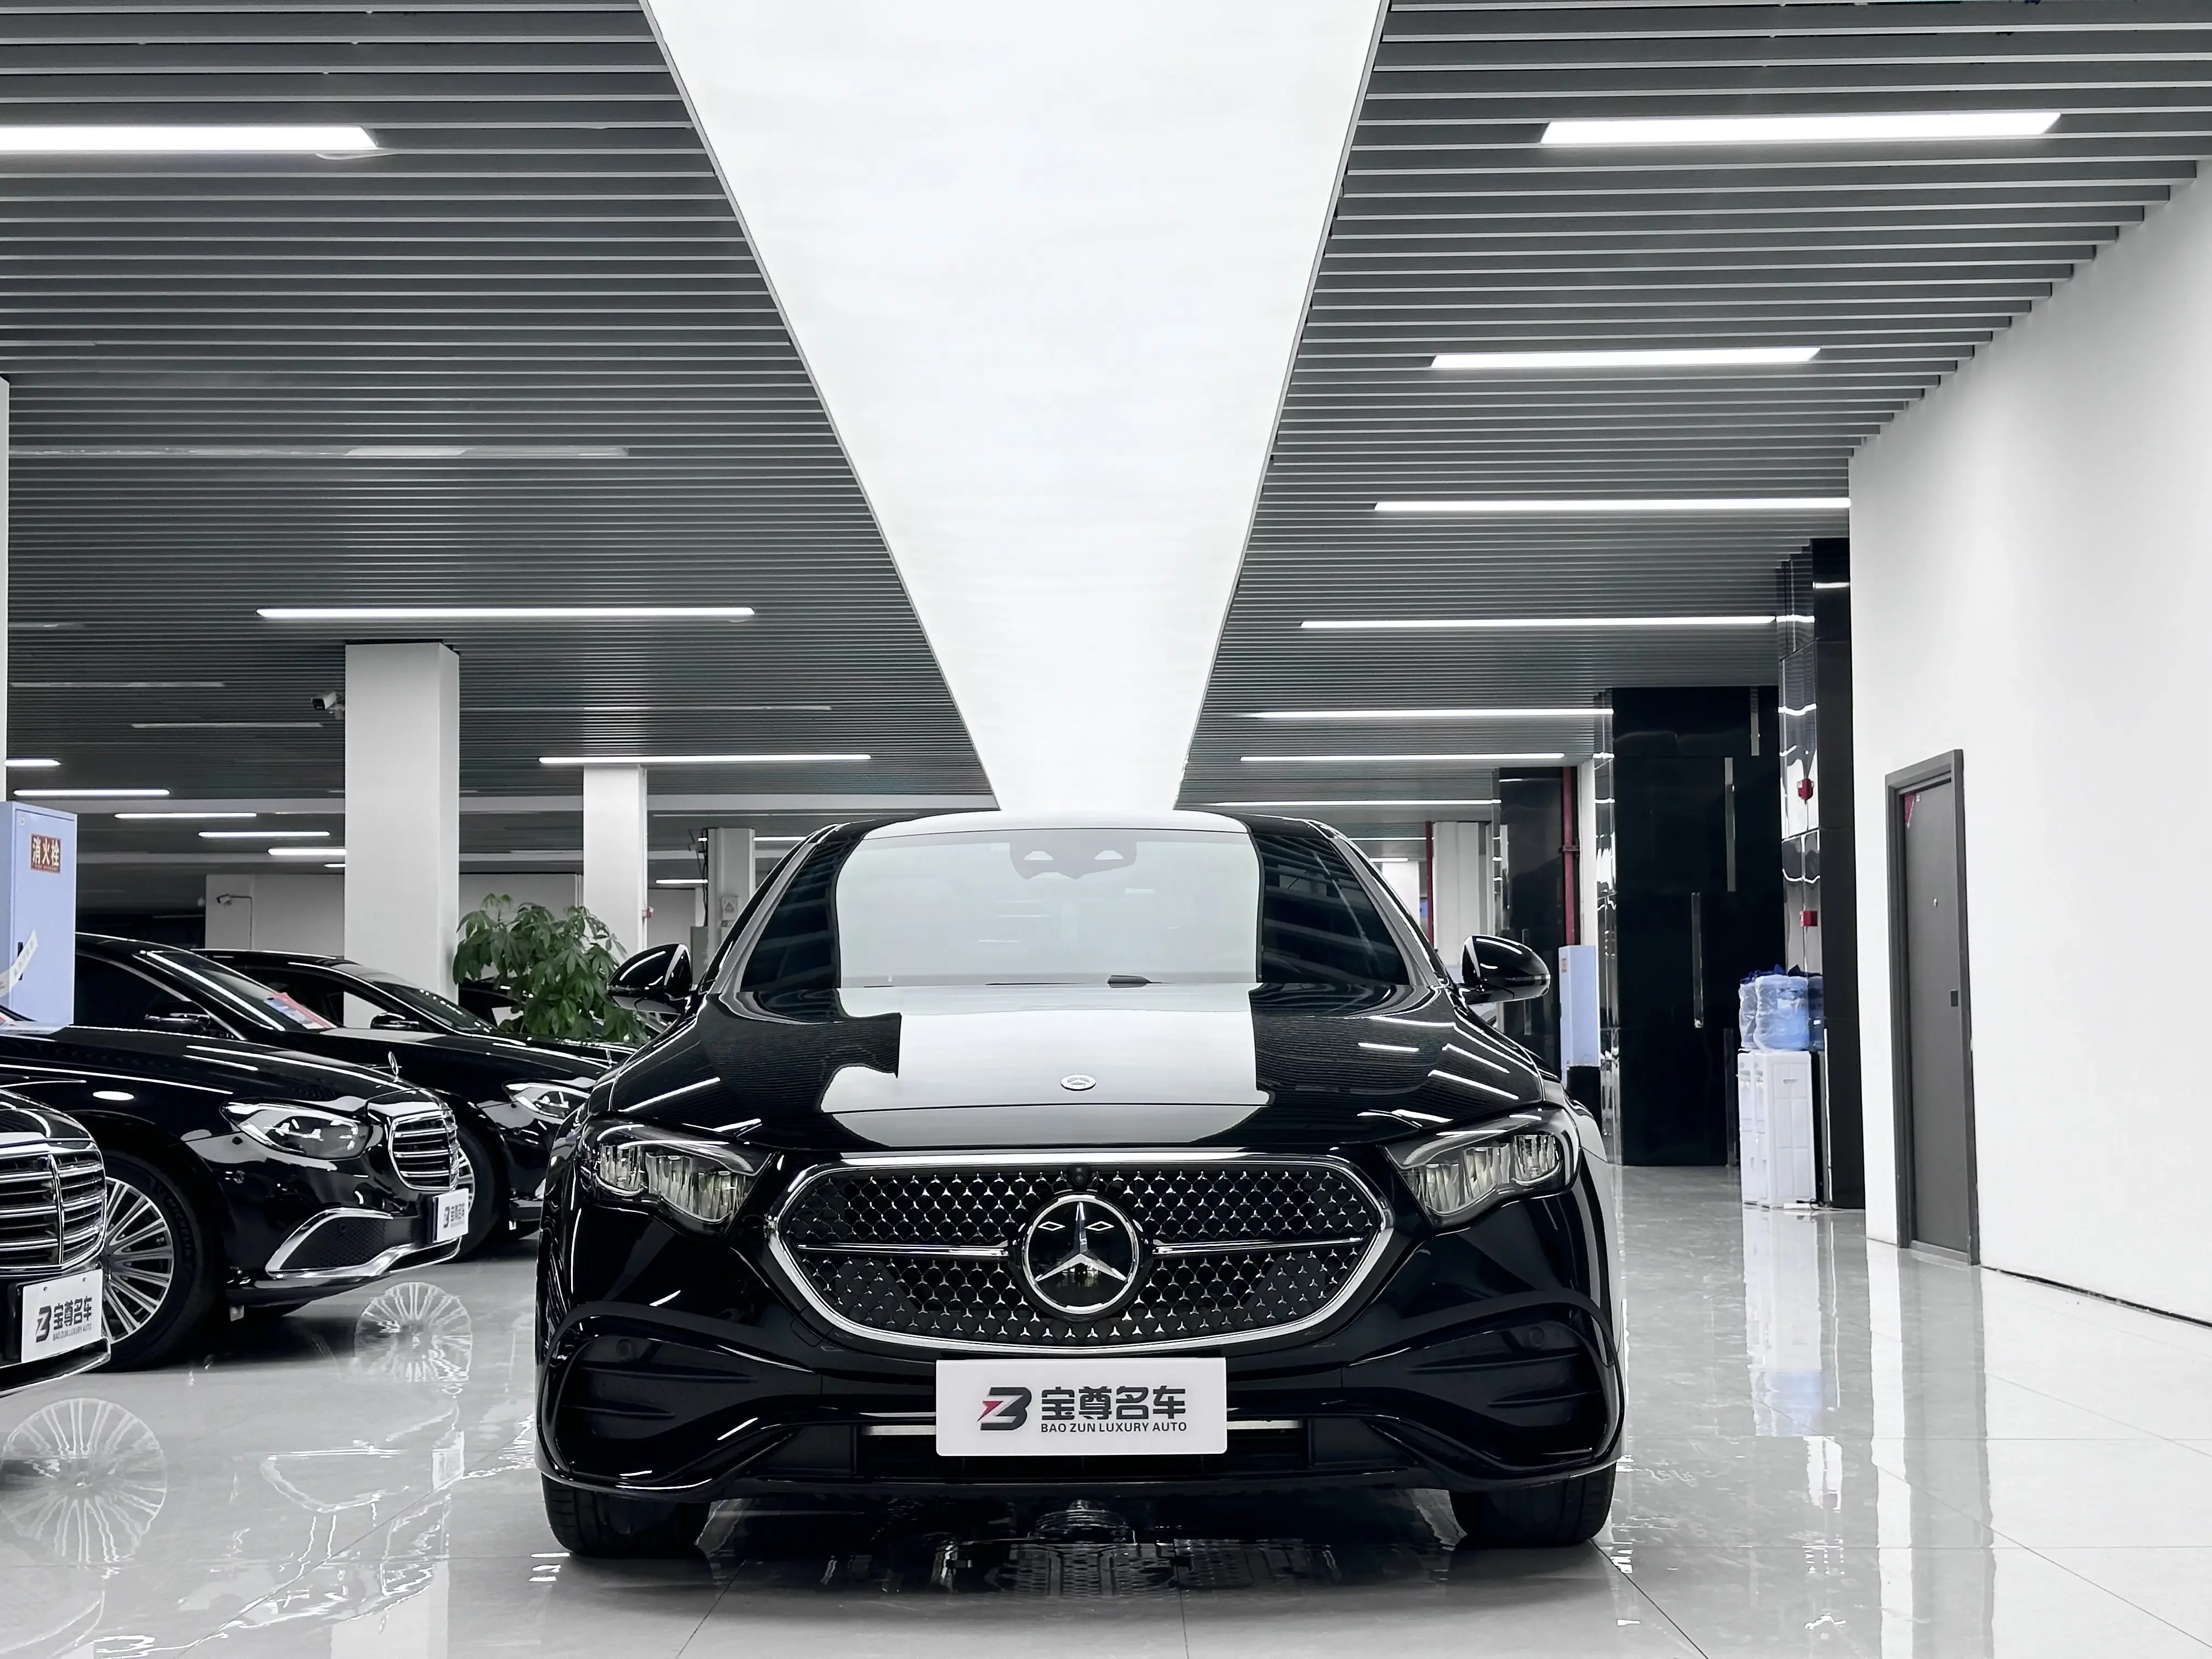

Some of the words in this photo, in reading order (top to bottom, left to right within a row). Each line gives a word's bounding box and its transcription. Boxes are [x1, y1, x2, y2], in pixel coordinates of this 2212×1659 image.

[33, 837, 60, 867] 消火栓
[54, 1295, 92, 1330] 宝尊名车
[1041, 1385, 1186, 1420] 宝尊名车
[1041, 1423, 1066, 1432] BAO
[1069, 1423, 1096, 1432] ZUN
[1099, 1422, 1149, 1432] LUXURY
[1152, 1421, 1187, 1431] AUTO
